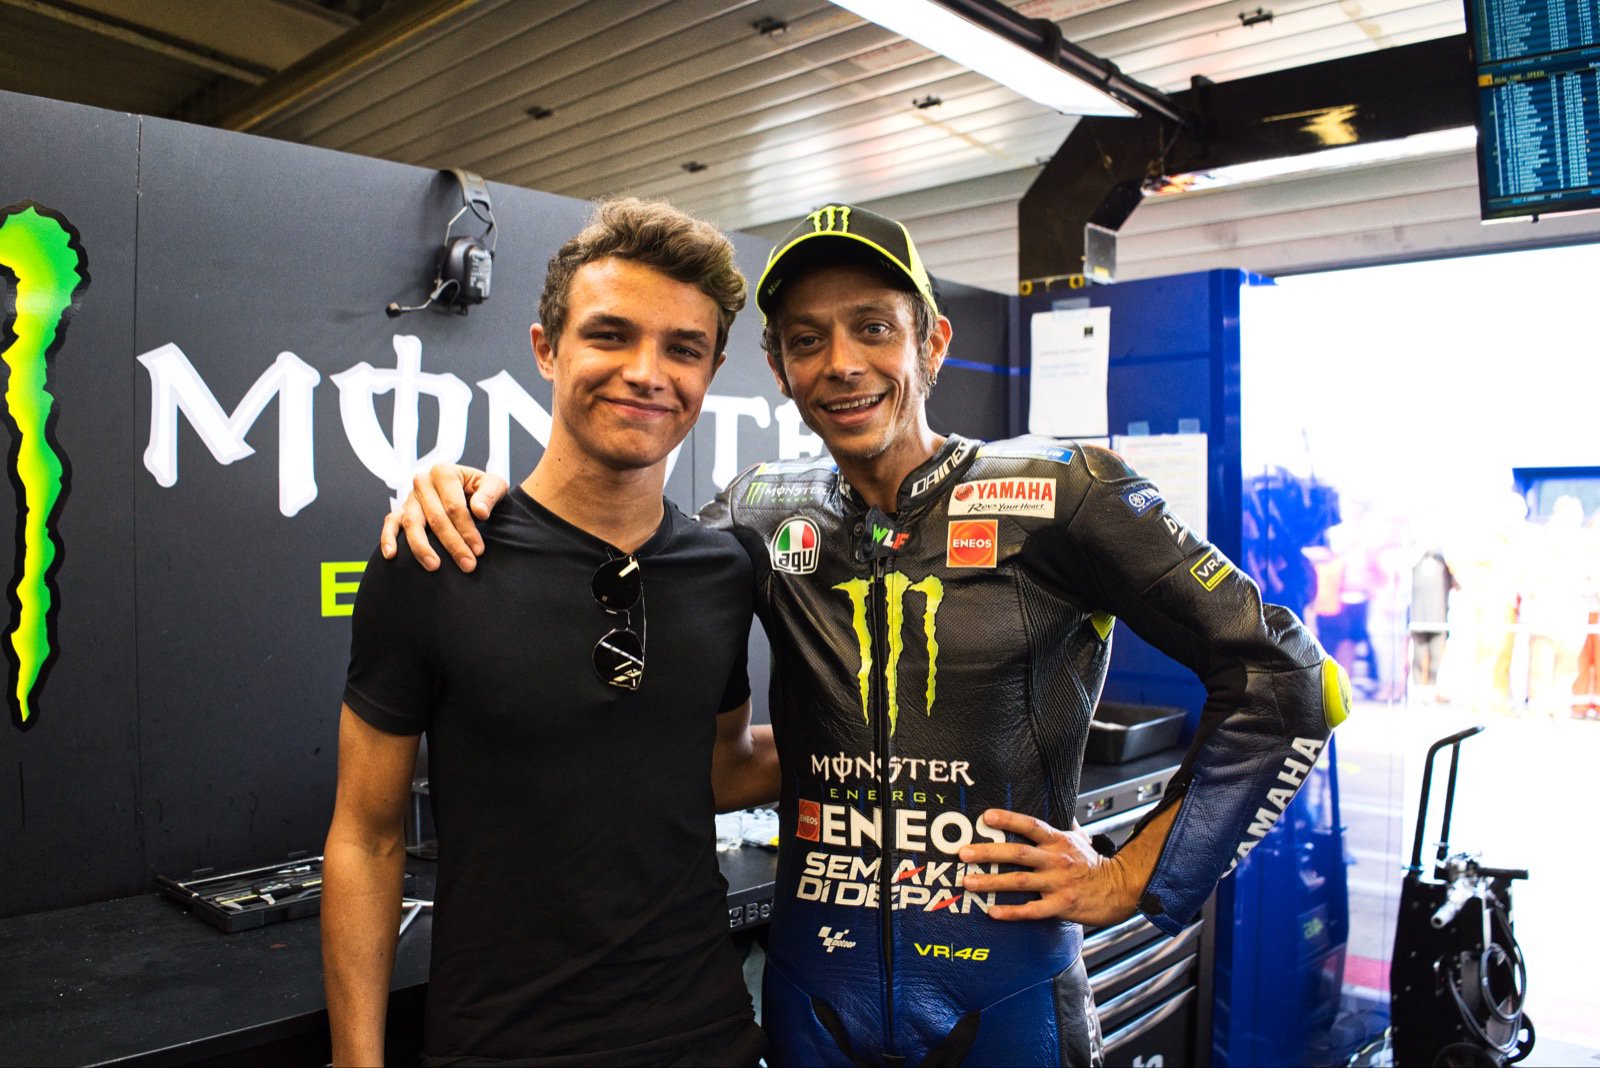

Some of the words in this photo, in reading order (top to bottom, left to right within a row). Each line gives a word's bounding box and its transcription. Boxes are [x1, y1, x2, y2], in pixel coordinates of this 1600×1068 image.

[977, 481, 1053, 501] YAMAHA
[998, 502, 1018, 512] Your
[1020, 502, 1045, 511] Heart
[872, 525, 910, 550] WLF
[953, 538, 993, 549] ENEOS
[811, 751, 975, 787] MONSTER
[830, 788, 948, 805] ENERGY
[822, 803, 1006, 855] ENEOS
